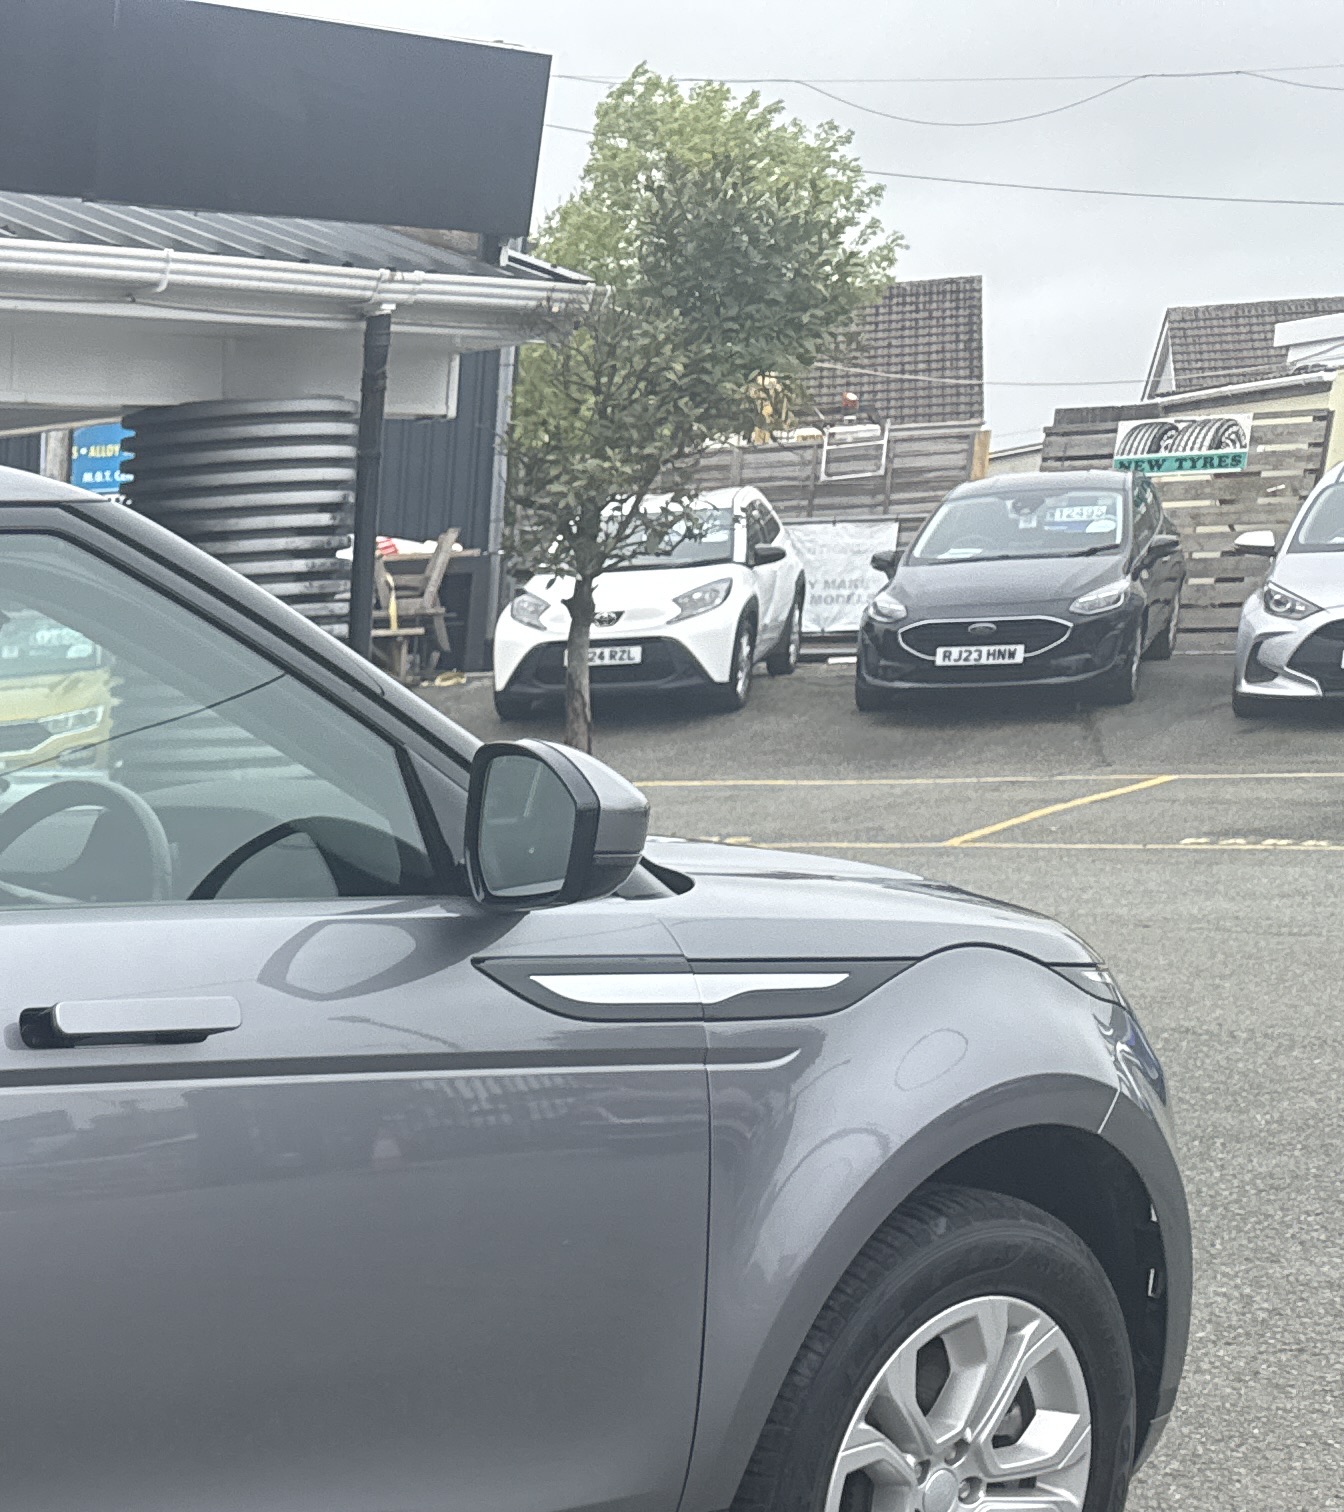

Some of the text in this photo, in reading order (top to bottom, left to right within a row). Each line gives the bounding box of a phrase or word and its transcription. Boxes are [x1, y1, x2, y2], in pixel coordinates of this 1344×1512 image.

[1118, 454, 1243, 473] NEW TYRES
[609, 649, 635, 661] RZL
[942, 648, 1017, 662] RJ23 HNW
